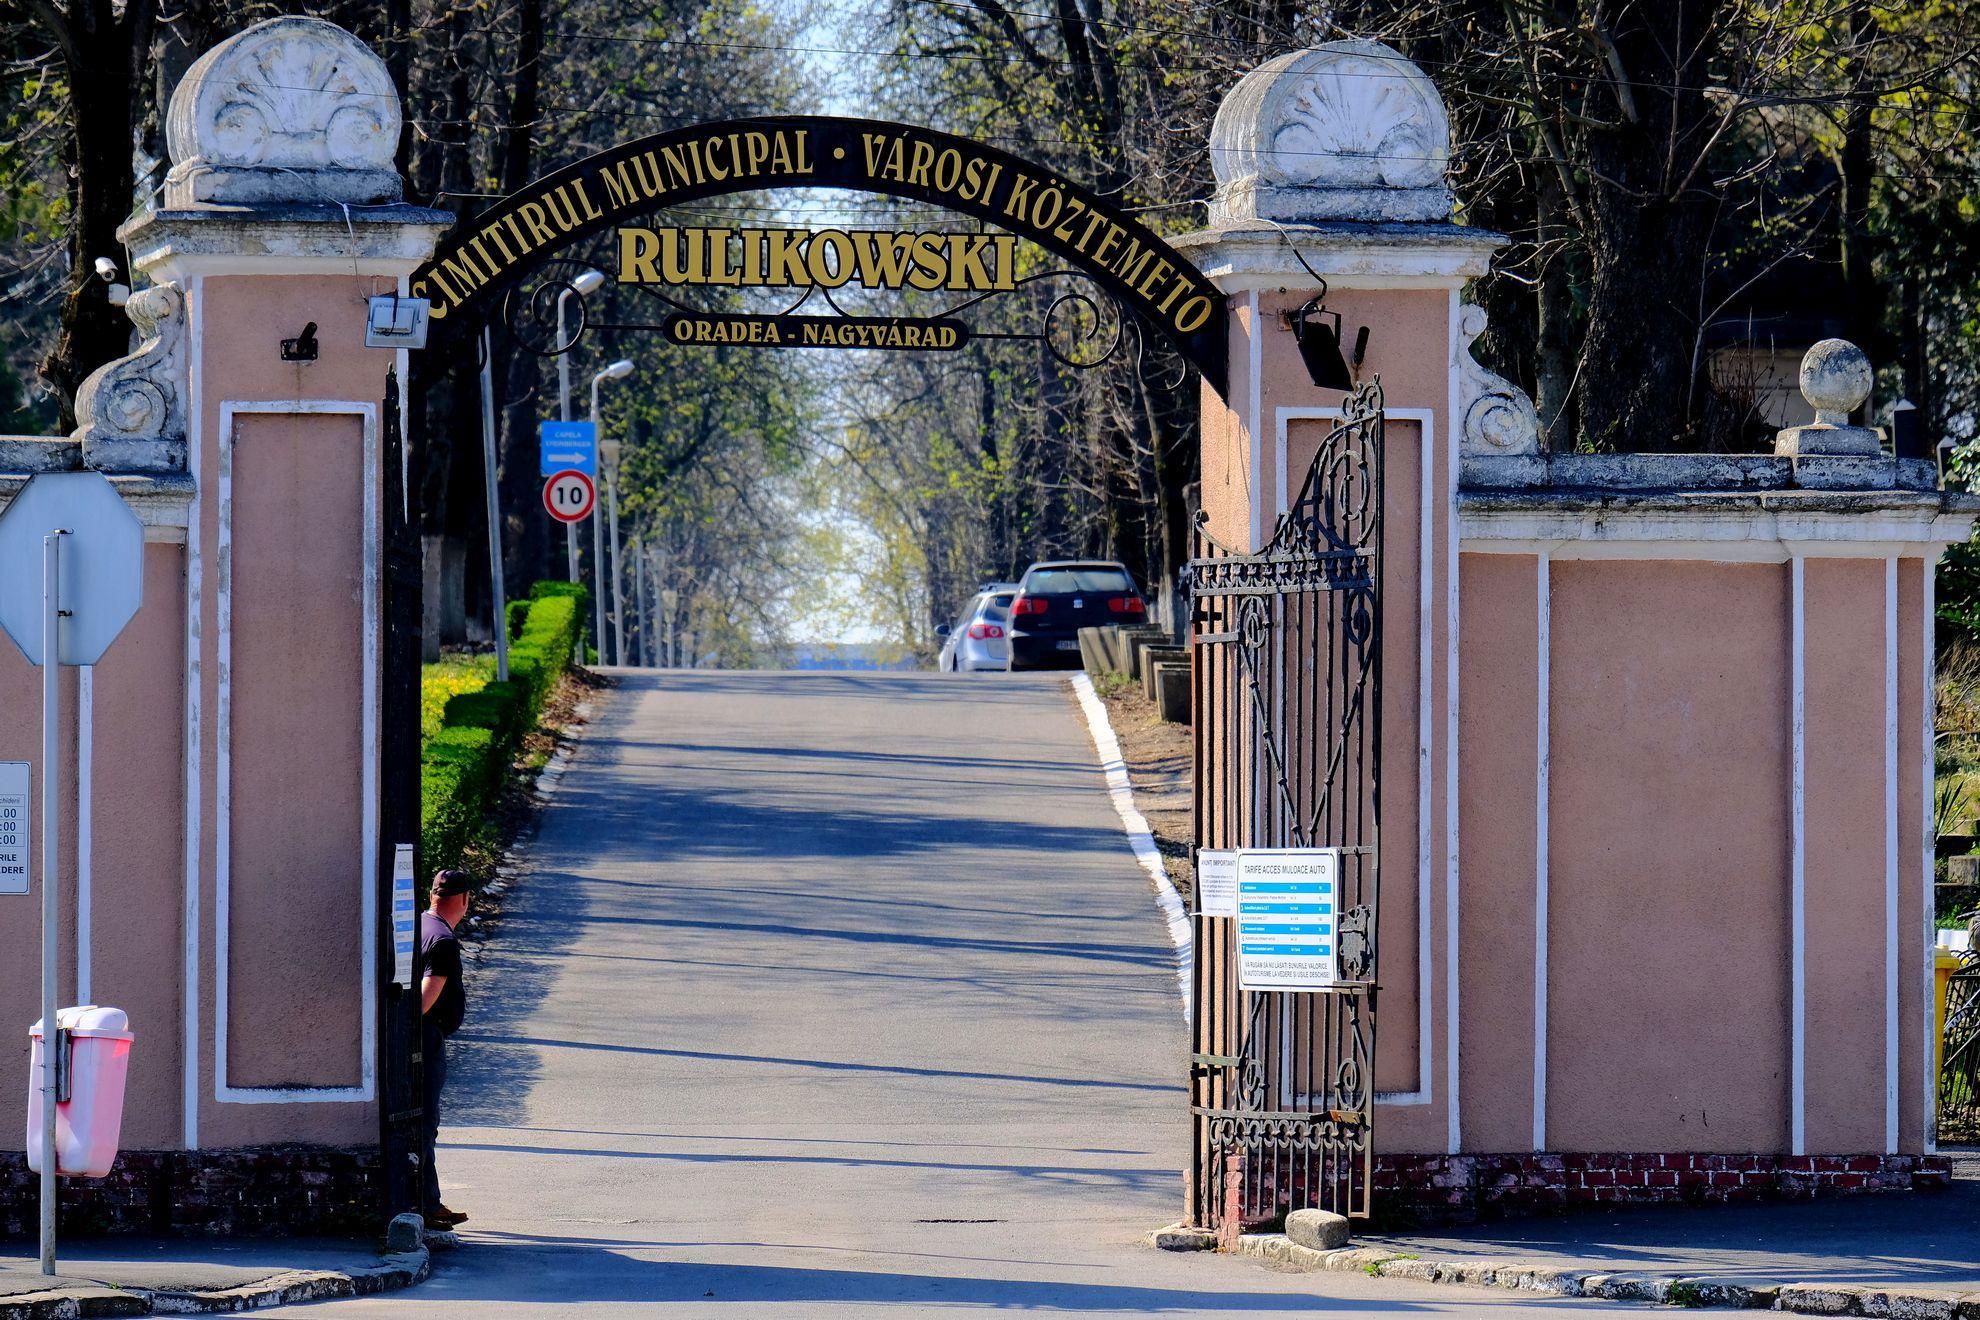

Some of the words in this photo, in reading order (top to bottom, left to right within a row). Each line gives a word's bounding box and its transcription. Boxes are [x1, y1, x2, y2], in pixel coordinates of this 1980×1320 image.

[862, 131, 1003, 206] VÁROSI
[412, 178, 603, 319] CIMITIRUL
[599, 130, 814, 210] MUNICIPAL
[618, 228, 1016, 290] RULIKOWSKI
[674, 319, 781, 343] ORADEA
[803, 318, 957, 347] NAGYVÁRAD
[557, 487, 582, 504] 10
[0, 866, 24, 874] DERE
[1244, 865, 1261, 874] TARIFE
[1262, 865, 1281, 874] ACCES
[1309, 865, 1326, 874] AUTO
